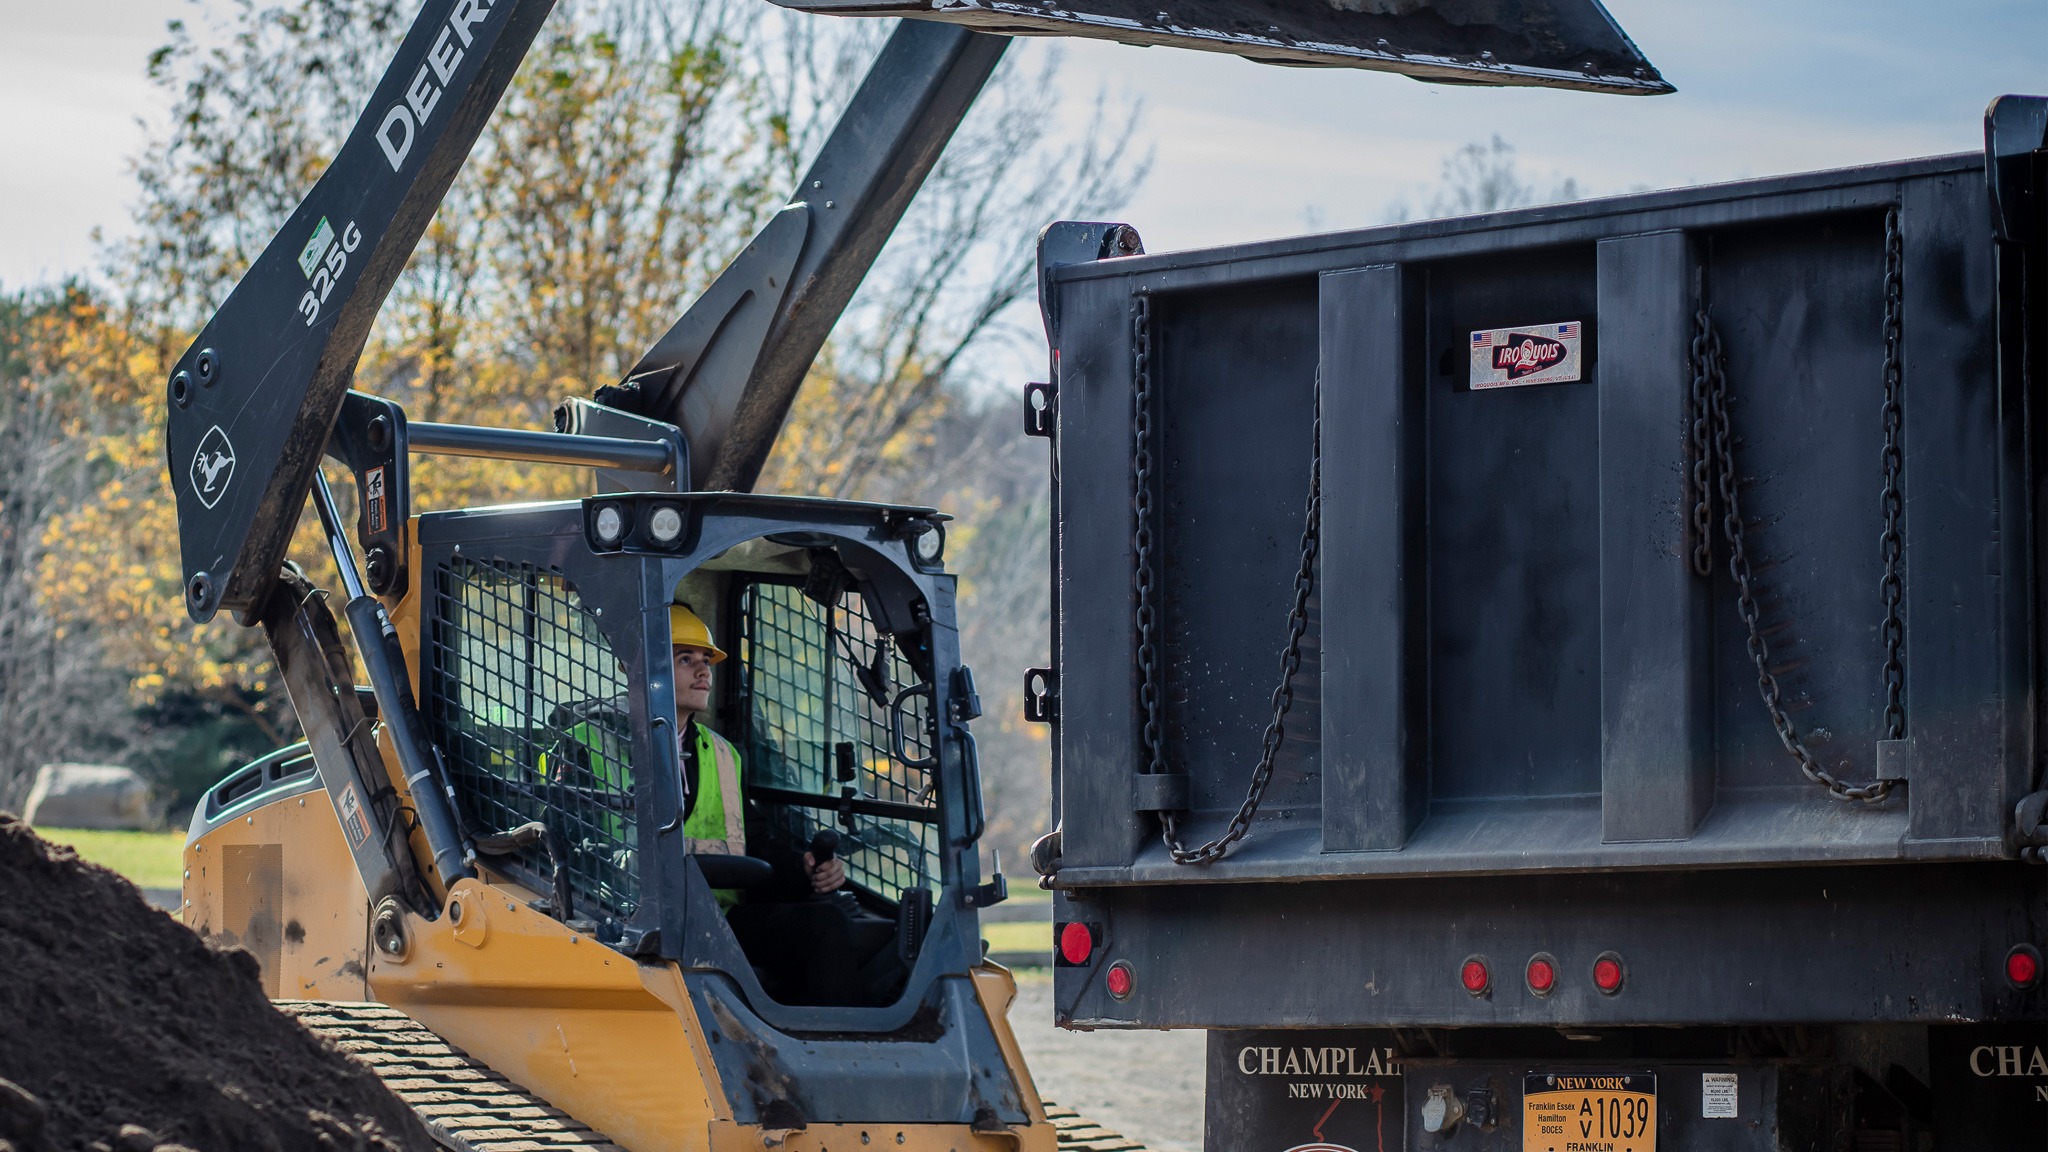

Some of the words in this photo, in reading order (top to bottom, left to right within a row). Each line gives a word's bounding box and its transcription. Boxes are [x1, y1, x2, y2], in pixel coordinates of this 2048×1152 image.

[375, 0, 497, 173] DEER
[298, 220, 362, 327] 325G
[1499, 339, 1560, 368] IROQUOIS
[1238, 1046, 1402, 1076] CHAMPLAI
[1969, 1045, 2048, 1077] CHA
[1288, 1083, 1324, 1098] NEW
[1326, 1084, 1367, 1099] YORK
[1557, 1077, 1587, 1090] NEW
[1589, 1077, 1625, 1090] YORK
[1528, 1102, 1556, 1111] Franklin
[1556, 1102, 1576, 1111] Essex
[1537, 1114, 1567, 1122] Hamilton
[1541, 1125, 1563, 1134] BOCES
[1566, 1142, 1614, 1152] FRANKLIN
